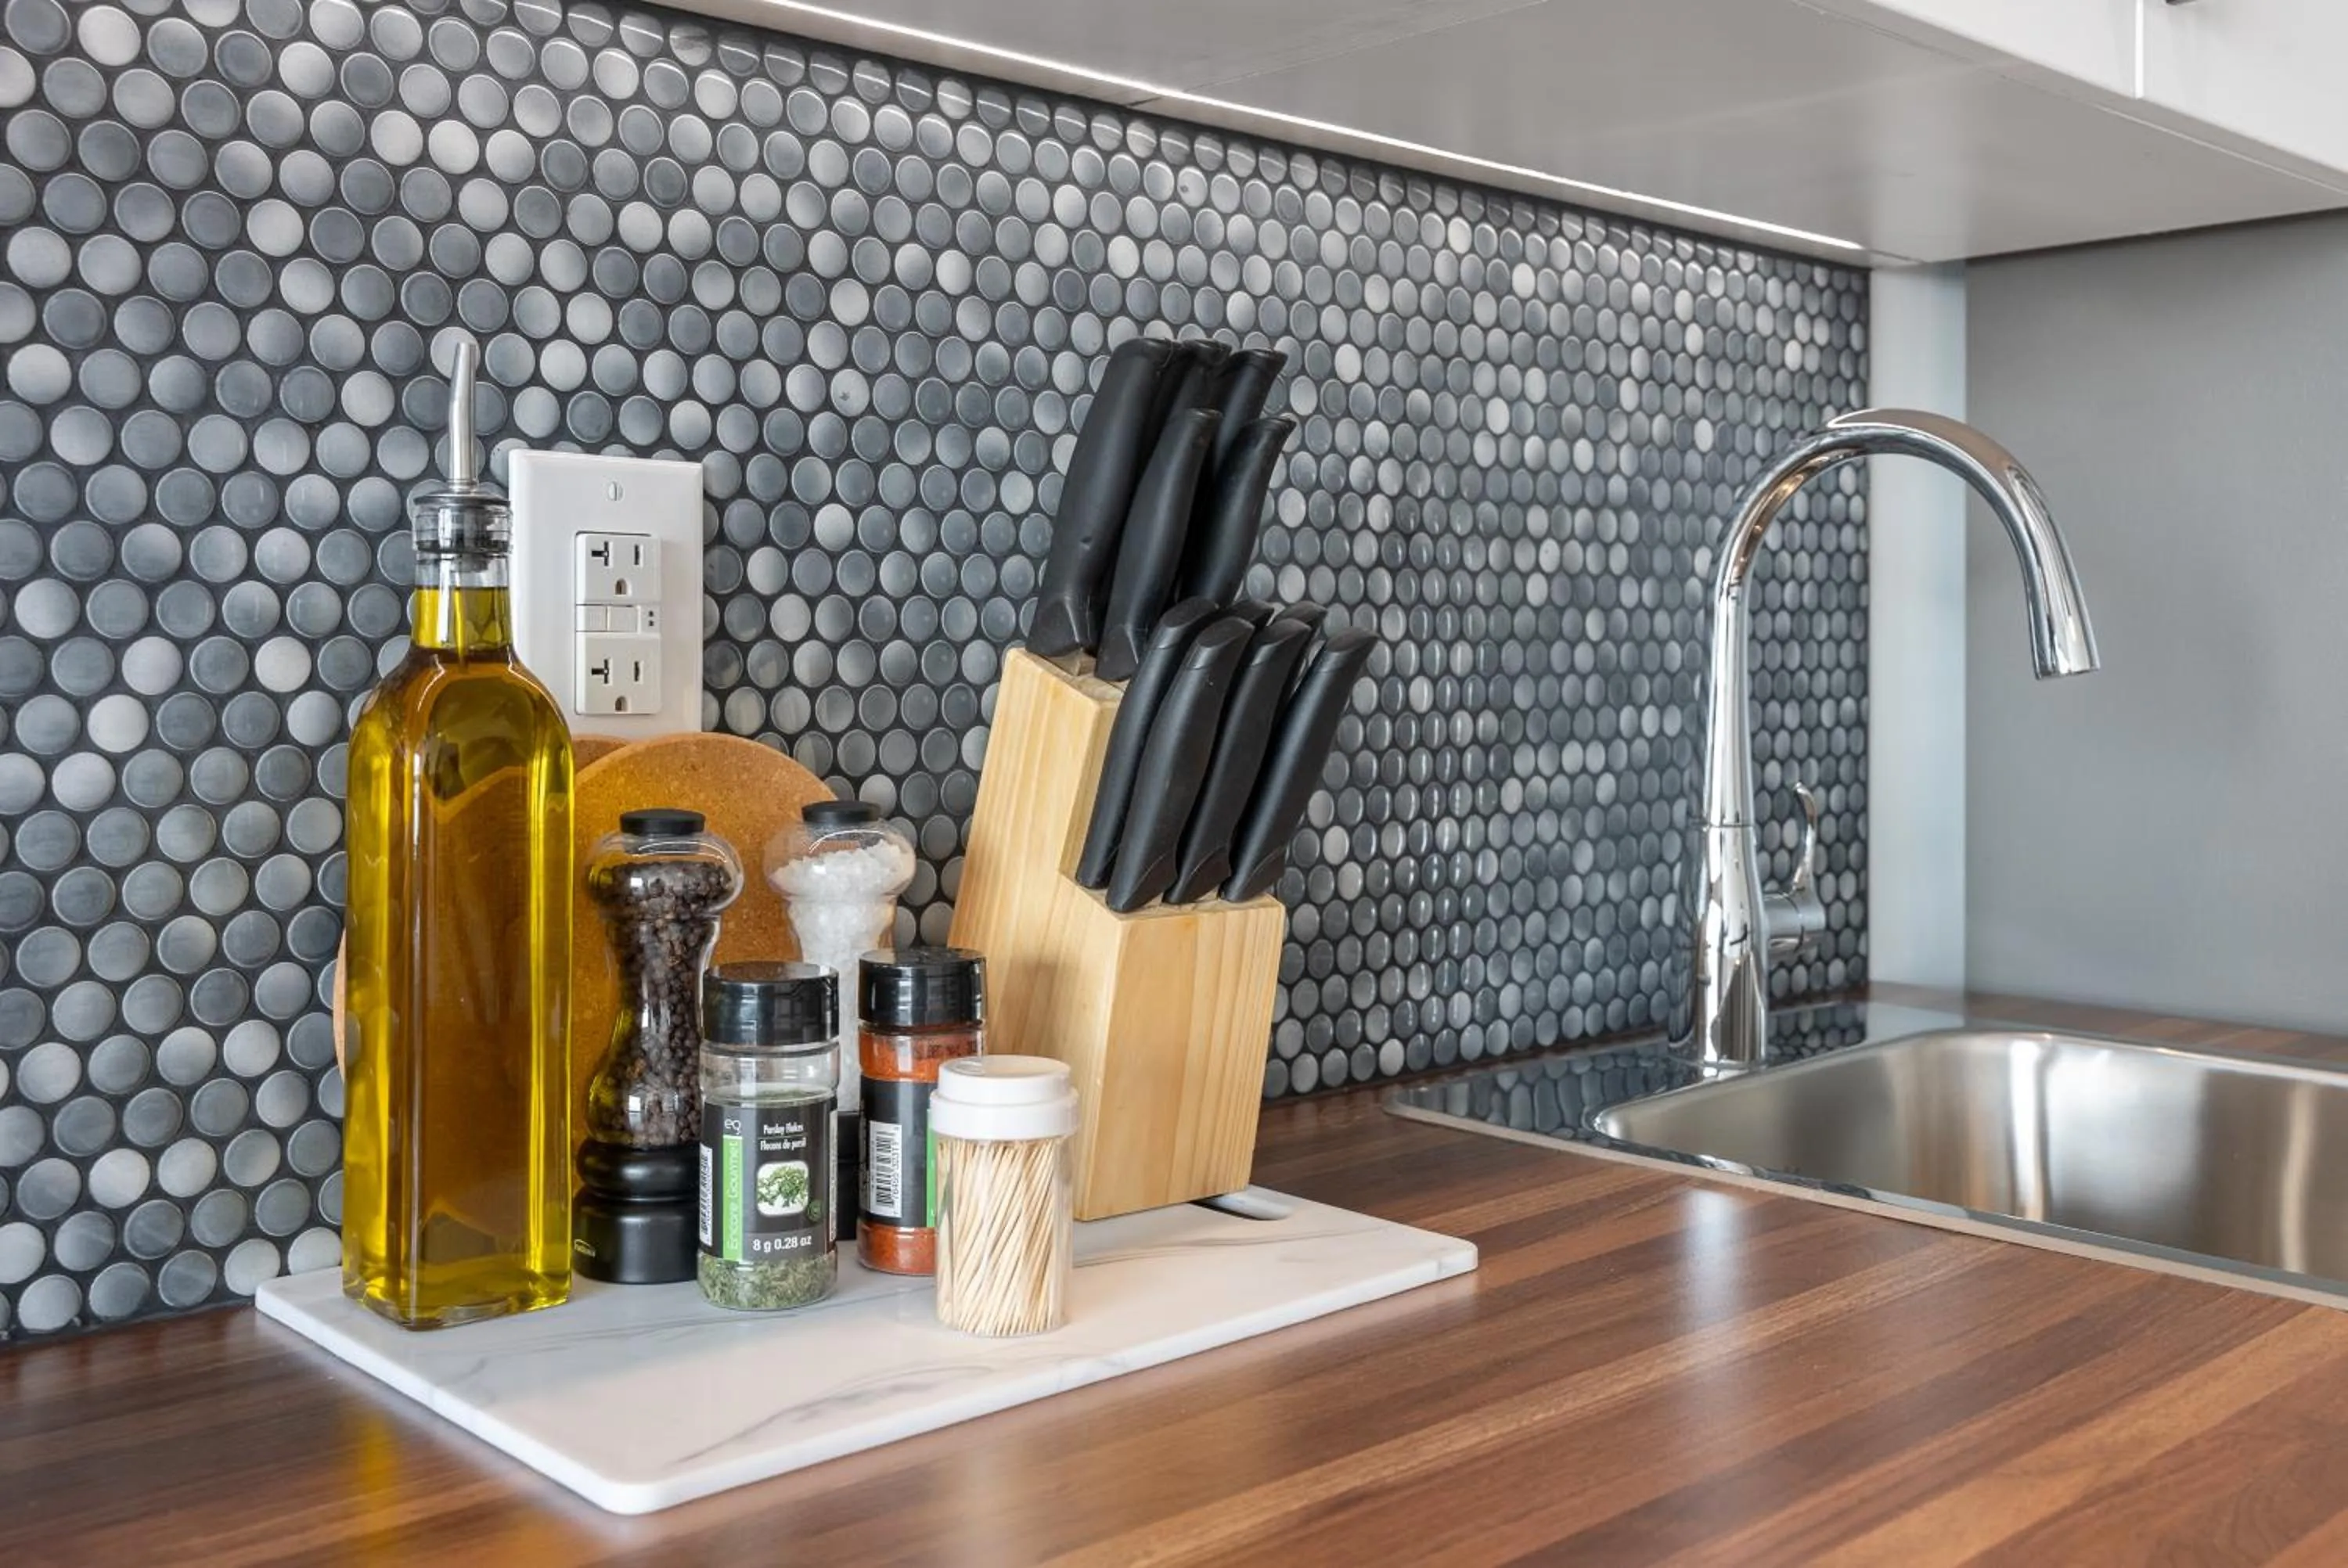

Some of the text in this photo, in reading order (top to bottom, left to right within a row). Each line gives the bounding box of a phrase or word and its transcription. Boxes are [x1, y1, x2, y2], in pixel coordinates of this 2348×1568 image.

[783, 1138, 790, 1149] de
[726, 1141, 738, 1250] Encore Gourmet
[752, 1235, 812, 1253] 8 g 0.28 oz
